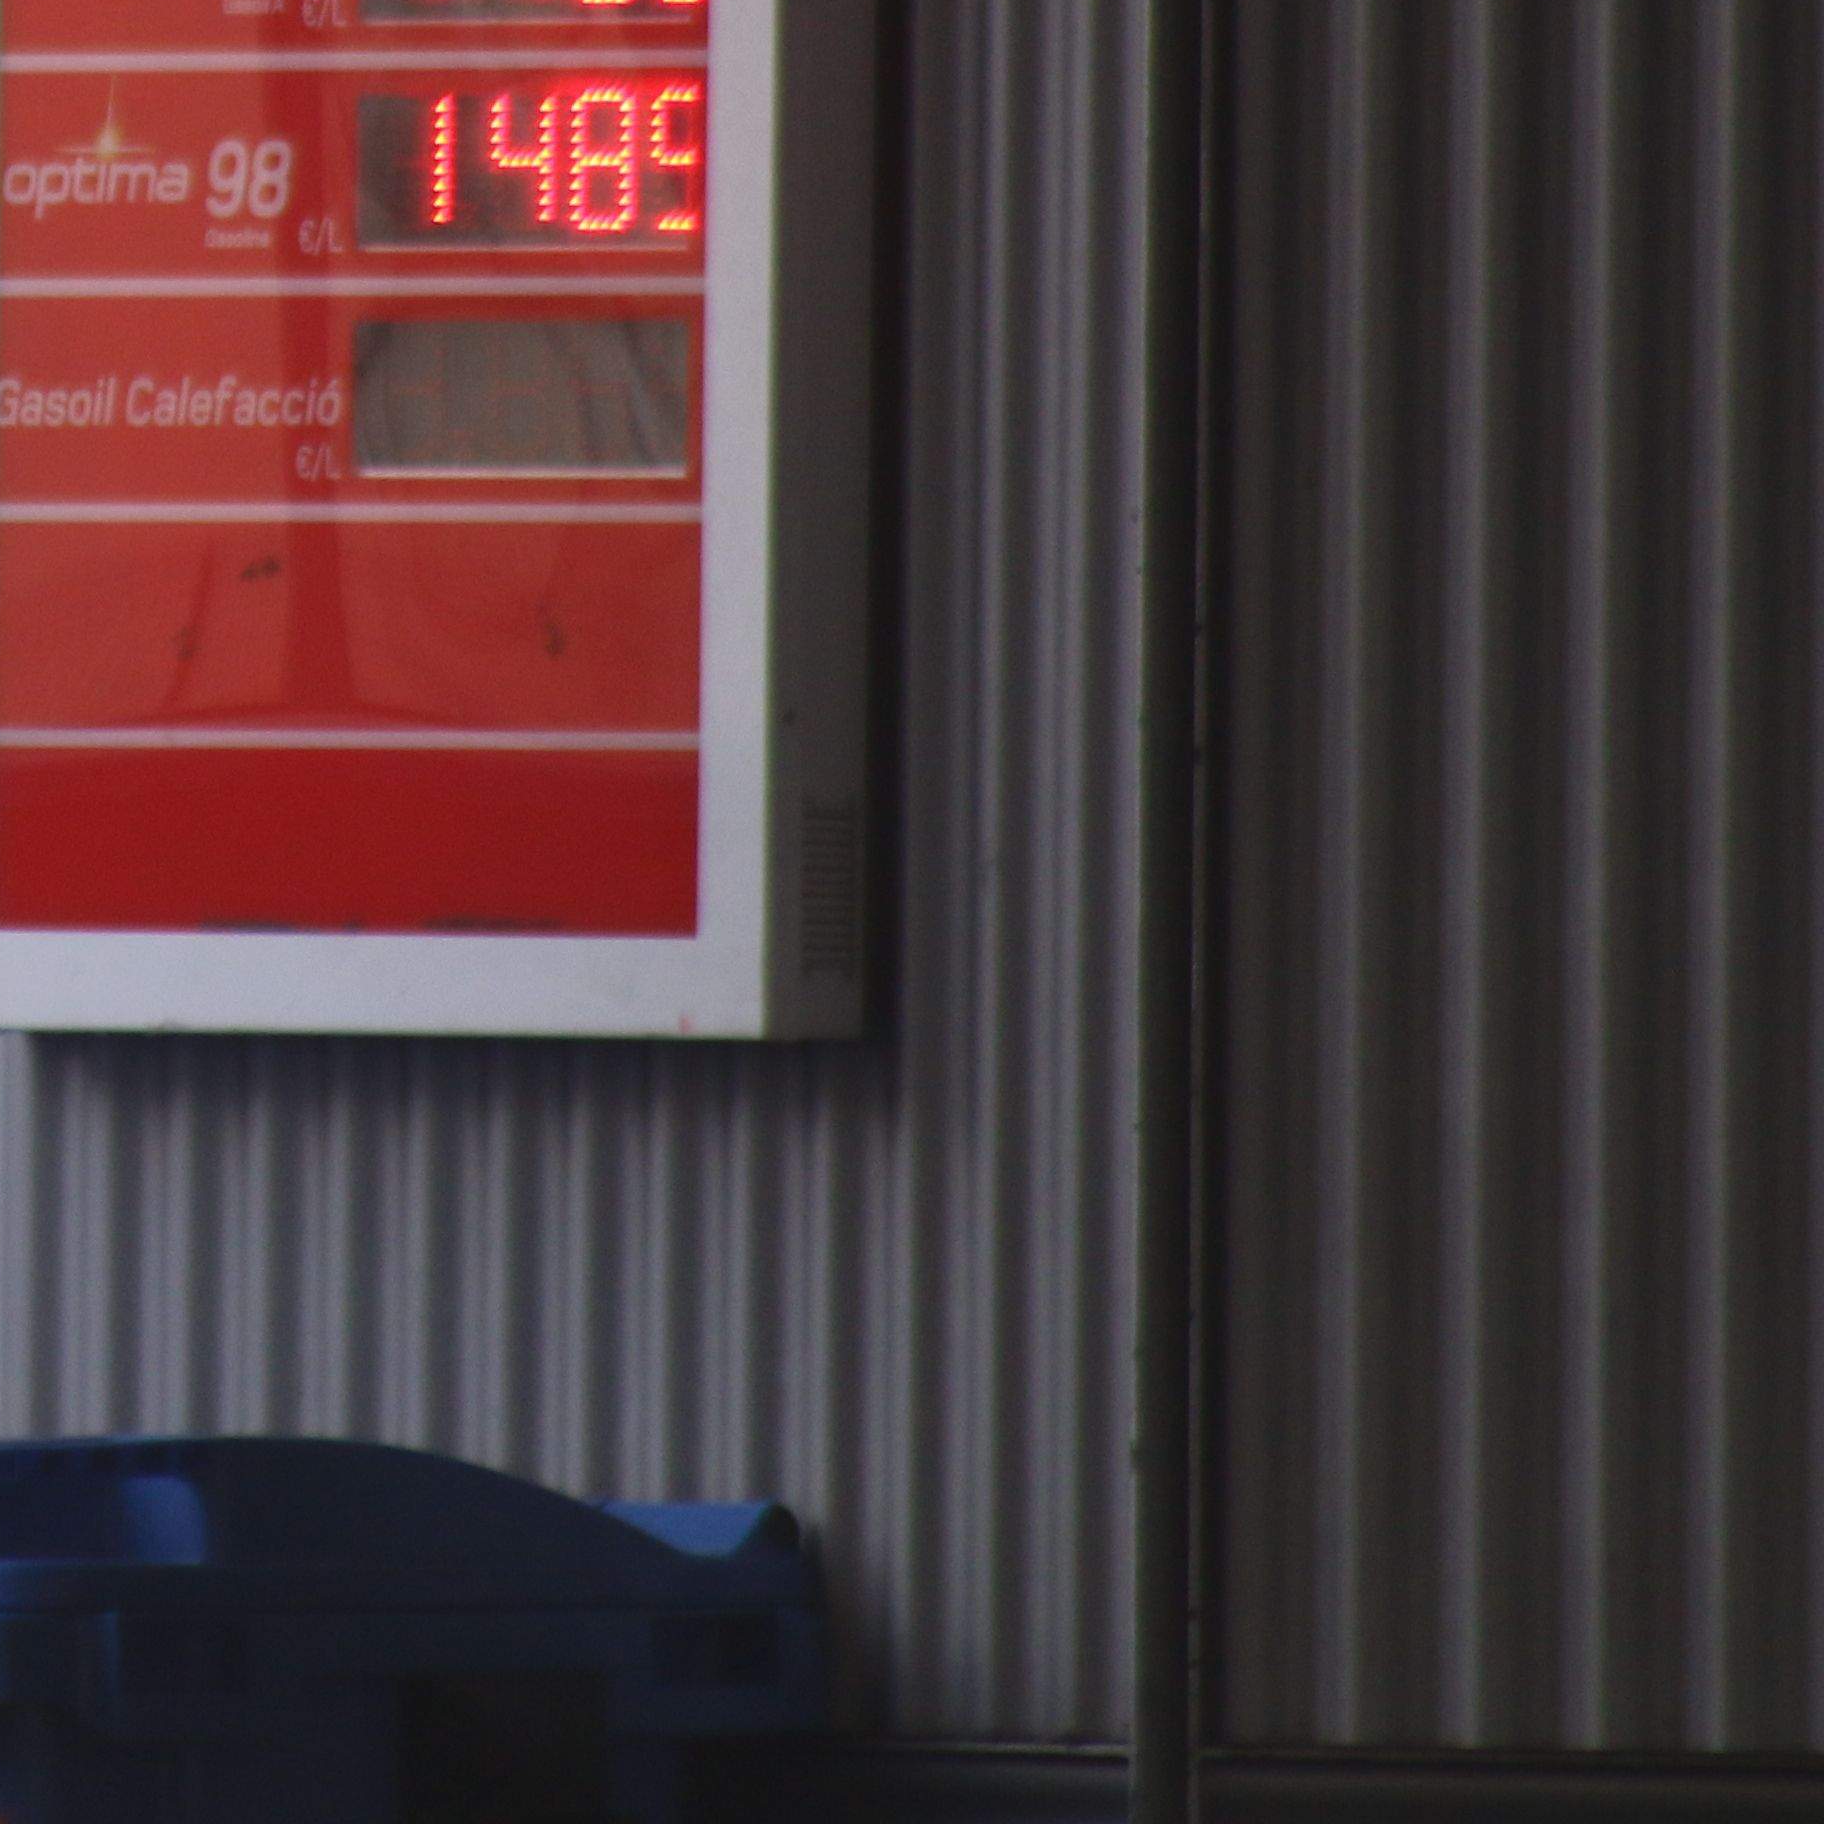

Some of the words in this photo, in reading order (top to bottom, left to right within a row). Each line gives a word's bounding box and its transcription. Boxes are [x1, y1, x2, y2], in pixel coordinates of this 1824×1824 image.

[2, 156, 189, 220] optima
[205, 139, 294, 218] 98
[125, 375, 343, 427] Calefacció
